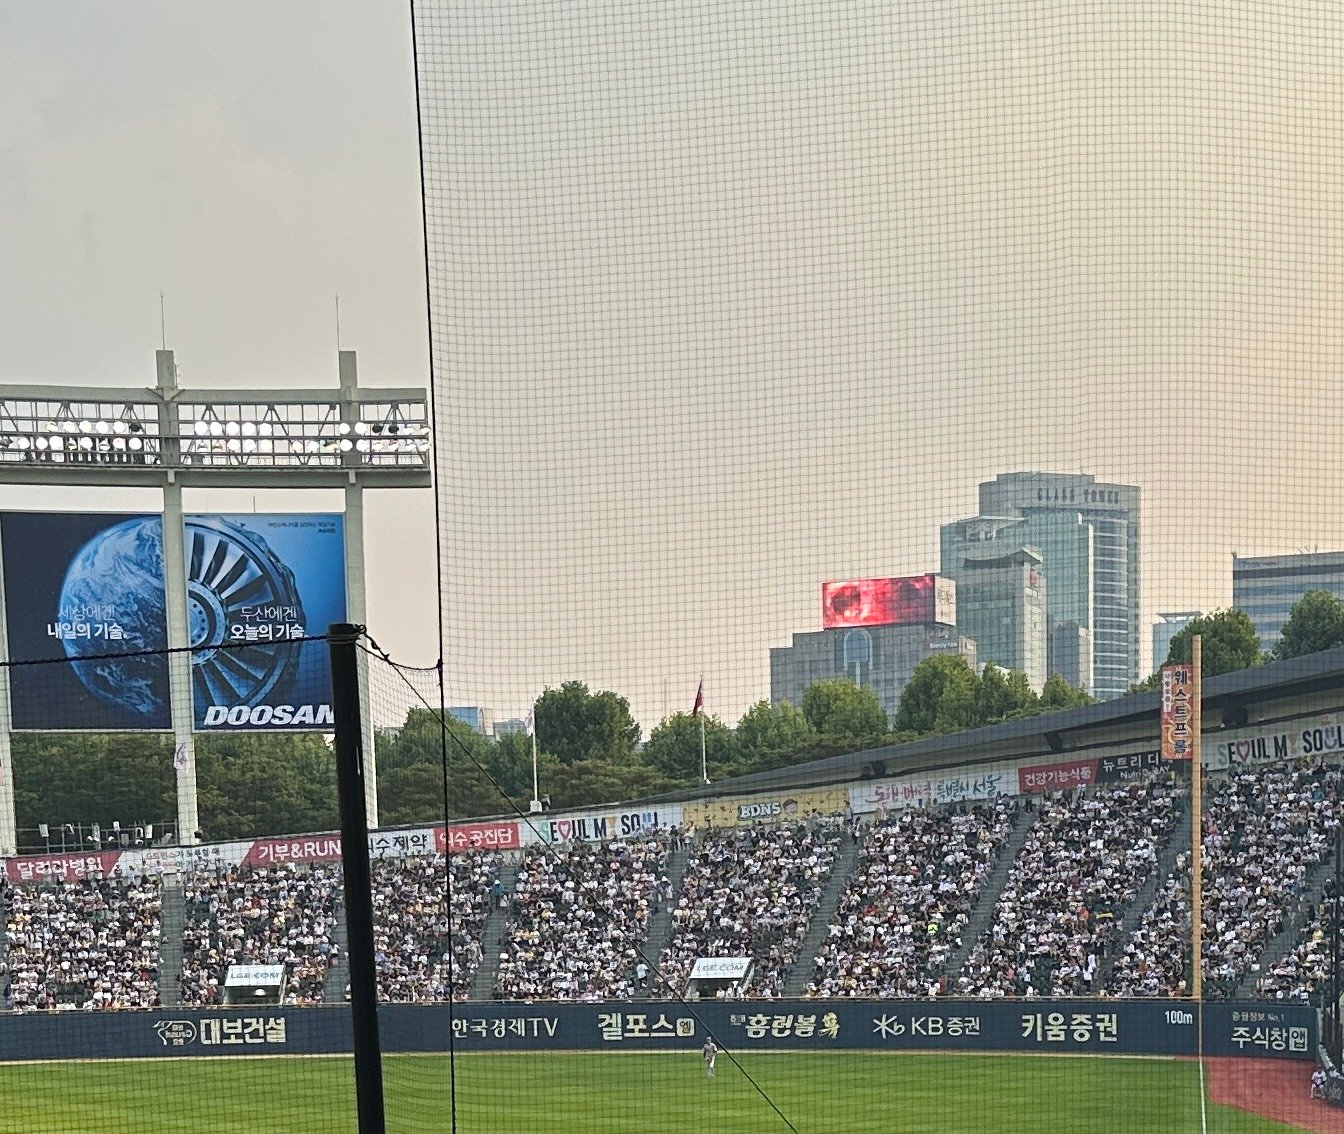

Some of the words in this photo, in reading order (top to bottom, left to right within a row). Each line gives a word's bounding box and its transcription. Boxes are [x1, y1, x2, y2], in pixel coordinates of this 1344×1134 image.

[58, 605, 115, 622] 세상에겐
[240, 606, 297, 622] 두산에겐
[47, 622, 91, 640] 내일의
[93, 622, 129, 640] 기술.
[230, 624, 273, 641] 오늘의
[204, 704, 335, 726] DOOSAN
[739, 801, 781, 819] BDNS
[947, 1016, 981, 1036] 증권
[1165, 1009, 1193, 1025] 100m
[200, 1017, 286, 1044] 대보건설
[451, 1017, 559, 1037] 한국경제TV
[1021, 1012, 1118, 1043] 키움증권
